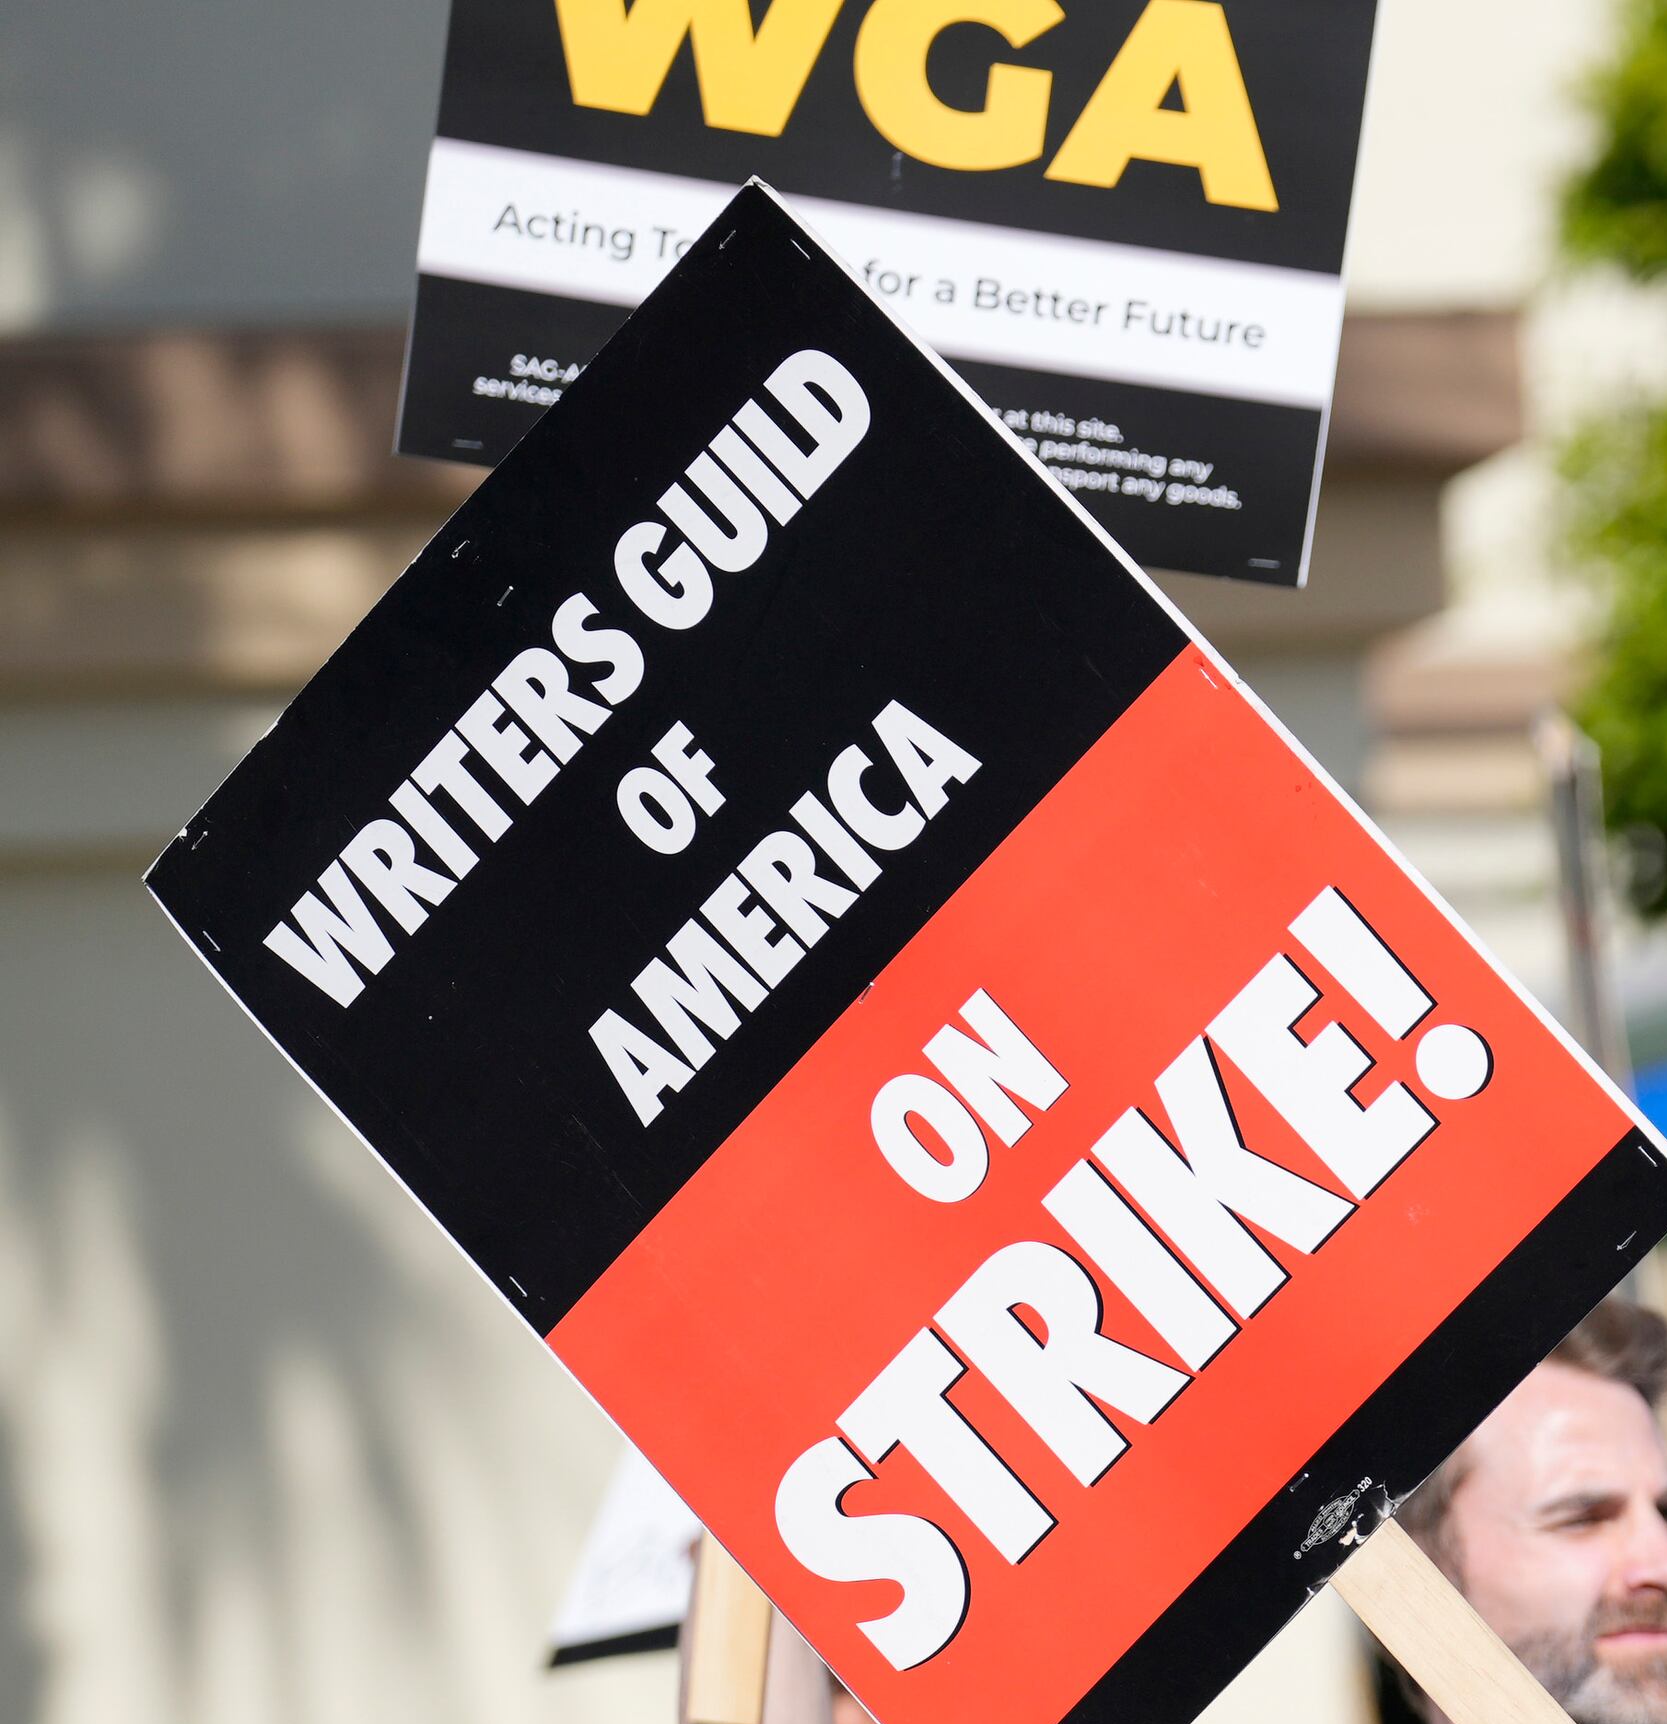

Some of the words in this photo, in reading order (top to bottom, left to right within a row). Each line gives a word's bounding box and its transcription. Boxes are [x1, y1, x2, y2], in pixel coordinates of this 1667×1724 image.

[555, 0, 1279, 212] WGA
[494, 203, 636, 262] Acting
[861, 258, 920, 298] for
[935, 280, 956, 306] a
[973, 277, 1106, 328] Better
[1123, 301, 1267, 350] Future
[263, 592, 644, 1009] WRITERS
[614, 350, 872, 630] GUILD
[616, 723, 727, 855] OF
[588, 699, 982, 1128] AMERICA
[870, 988, 1070, 1204] ON
[774, 885, 1495, 1672] STRIKE!
[1357, 1476, 1372, 1492] 320
